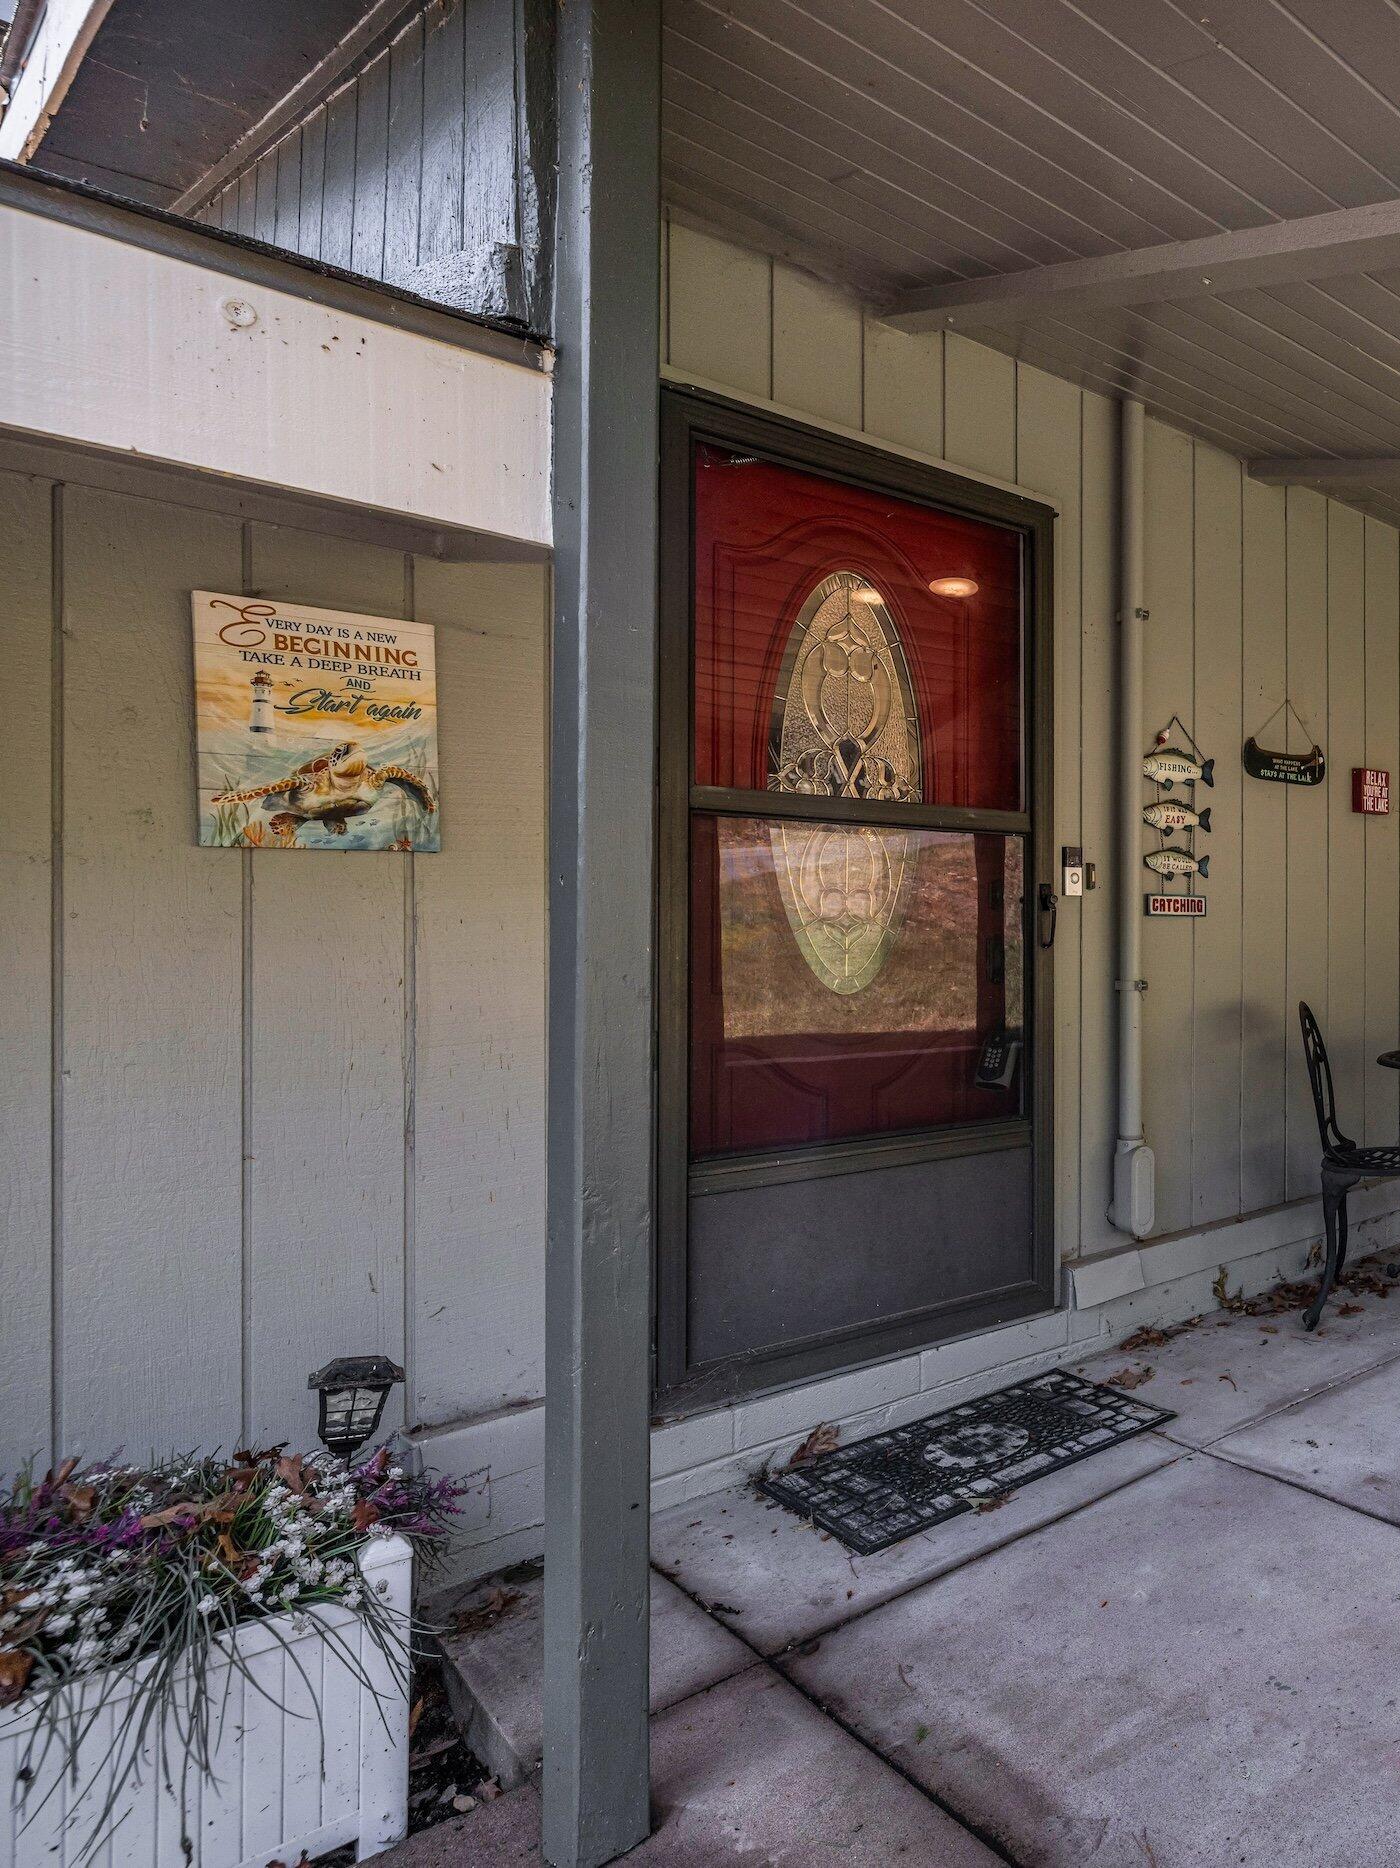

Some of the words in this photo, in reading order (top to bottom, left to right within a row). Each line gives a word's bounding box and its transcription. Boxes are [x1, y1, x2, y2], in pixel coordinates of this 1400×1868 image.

[306, 622, 333, 637] DAY
[337, 627, 350, 639] IS
[353, 631, 363, 641] A
[367, 631, 397, 645] NEW
[274, 633, 418, 667] BEGINNING
[238, 650, 285, 666] TAKE
[290, 656, 302, 668] A
[308, 658, 352, 673] DEEP
[358, 664, 422, 681] BREATH
[346, 678, 371, 690] AND
[274, 688, 372, 715] Start
[366, 701, 422, 723] again
[1260, 769, 1278, 778] STAYS
[1286, 772, 1297, 781] THE
[1366, 770, 1387, 787] RELAX
[1381, 787, 1389, 799] AT
[1363, 796, 1374, 811] THE
[1375, 797, 1389, 813] LAKE
[1165, 814, 1186, 824] EASY
[1152, 898, 1203, 913] CATCHING
